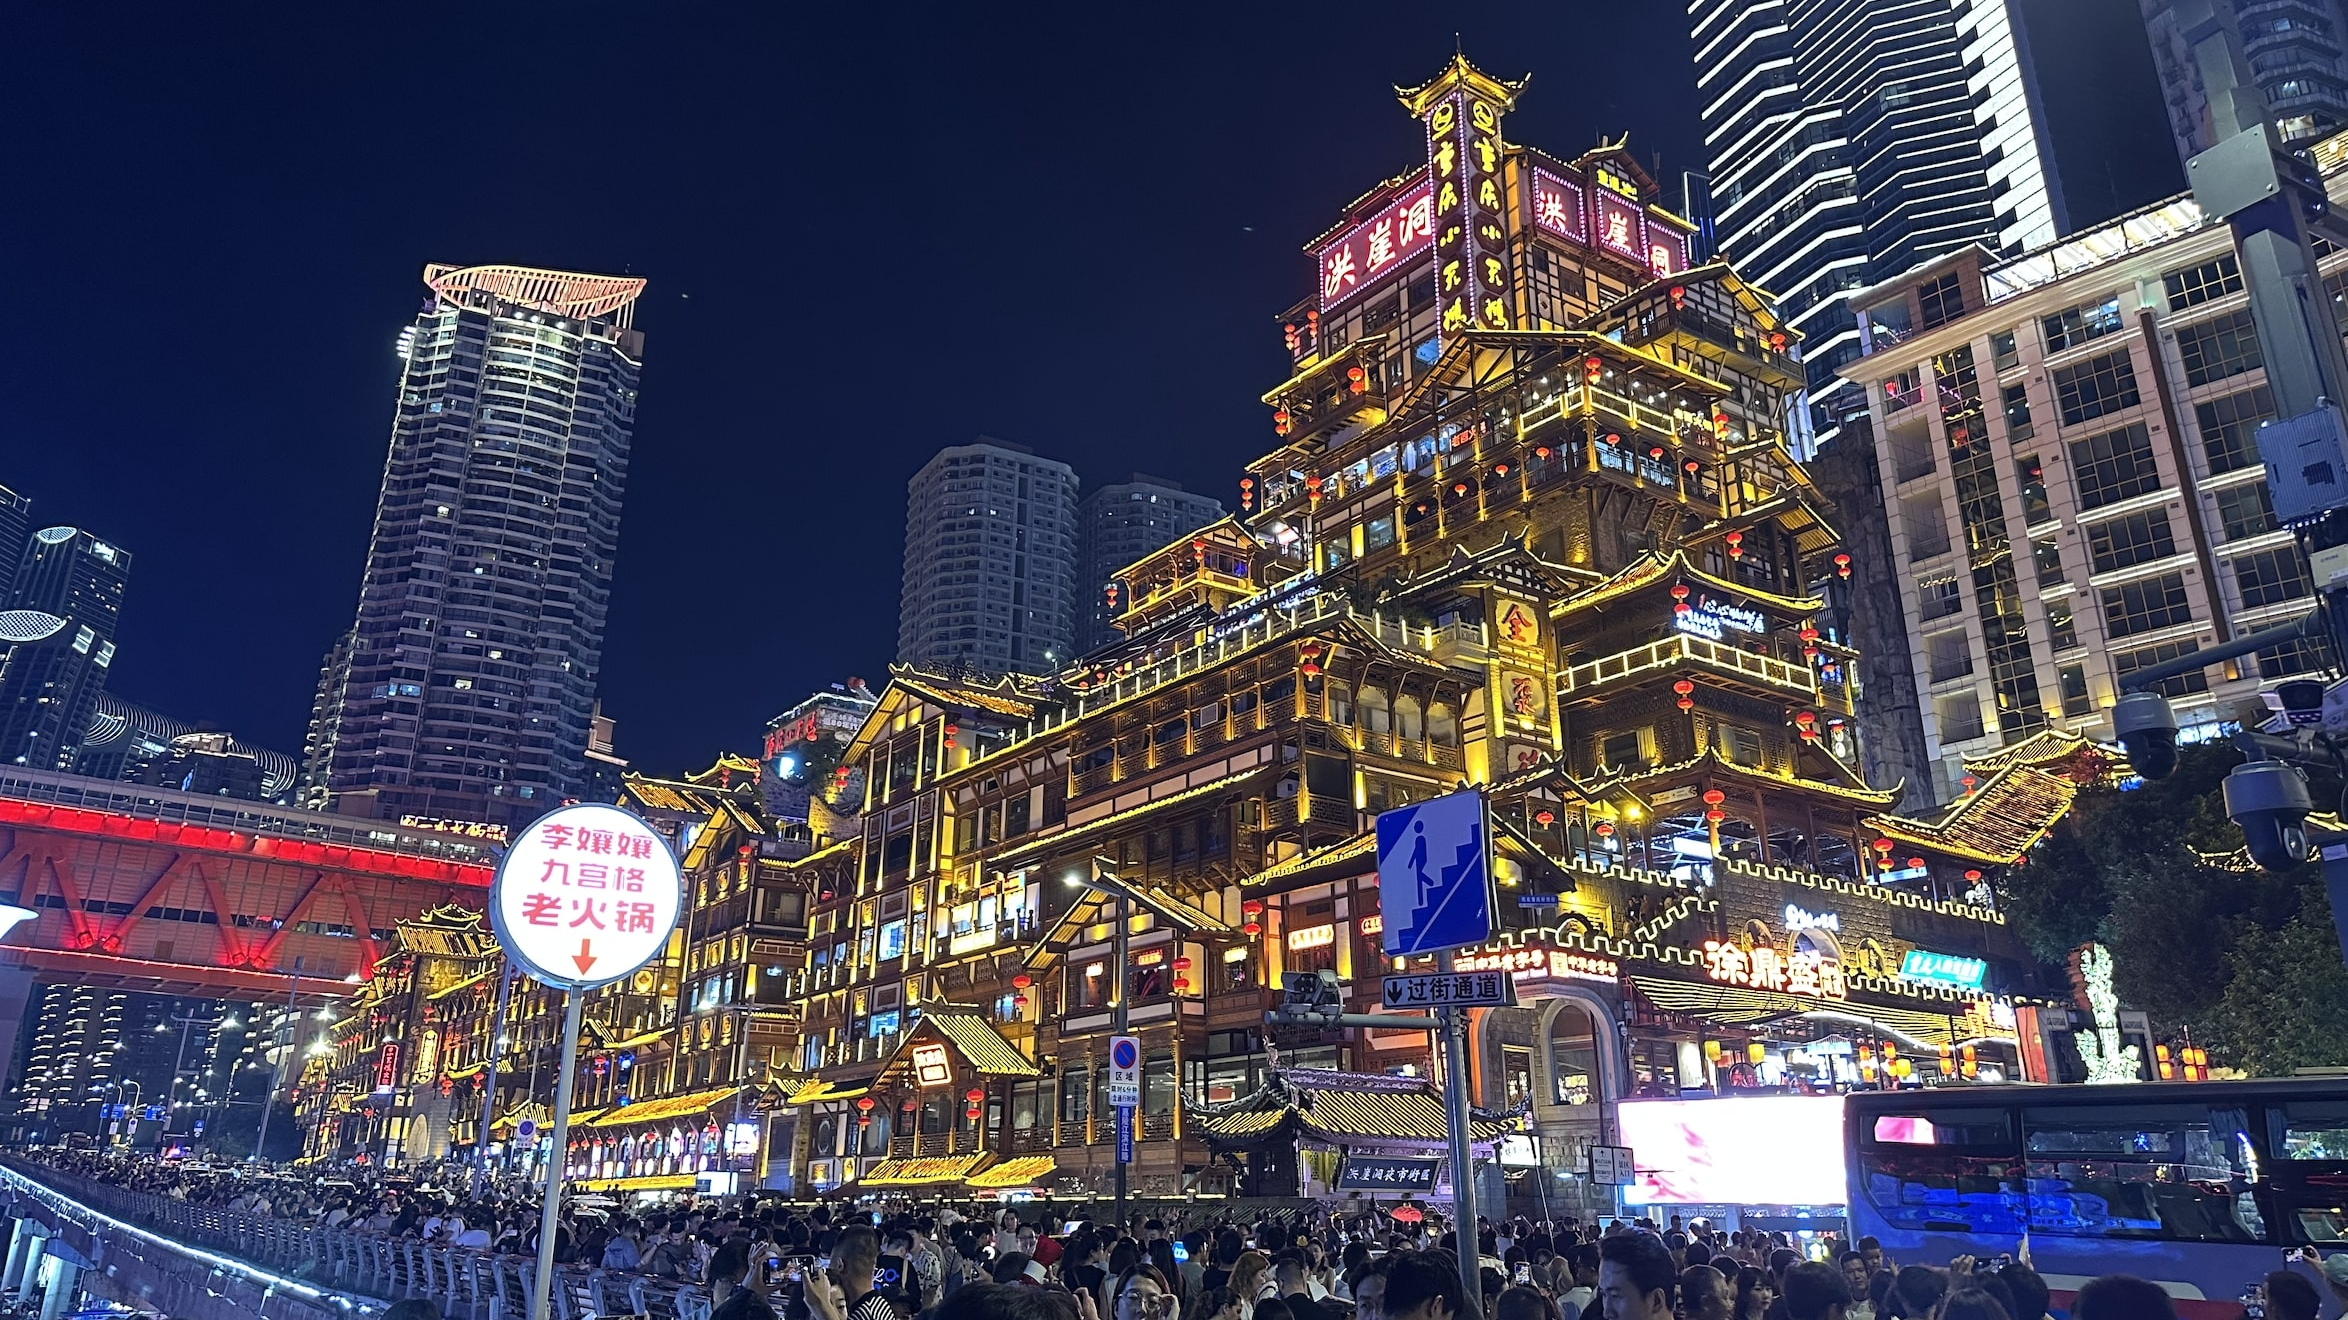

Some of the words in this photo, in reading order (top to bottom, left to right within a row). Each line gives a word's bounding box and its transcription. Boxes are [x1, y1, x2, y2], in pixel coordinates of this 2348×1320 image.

[1325, 195, 1432, 298] 洪崖洞
[541, 859, 645, 892] 九宫格
[522, 893, 655, 933] 老火锅
[1407, 974, 1499, 1001] 过街通道
[1115, 1071, 1133, 1082] 区域
